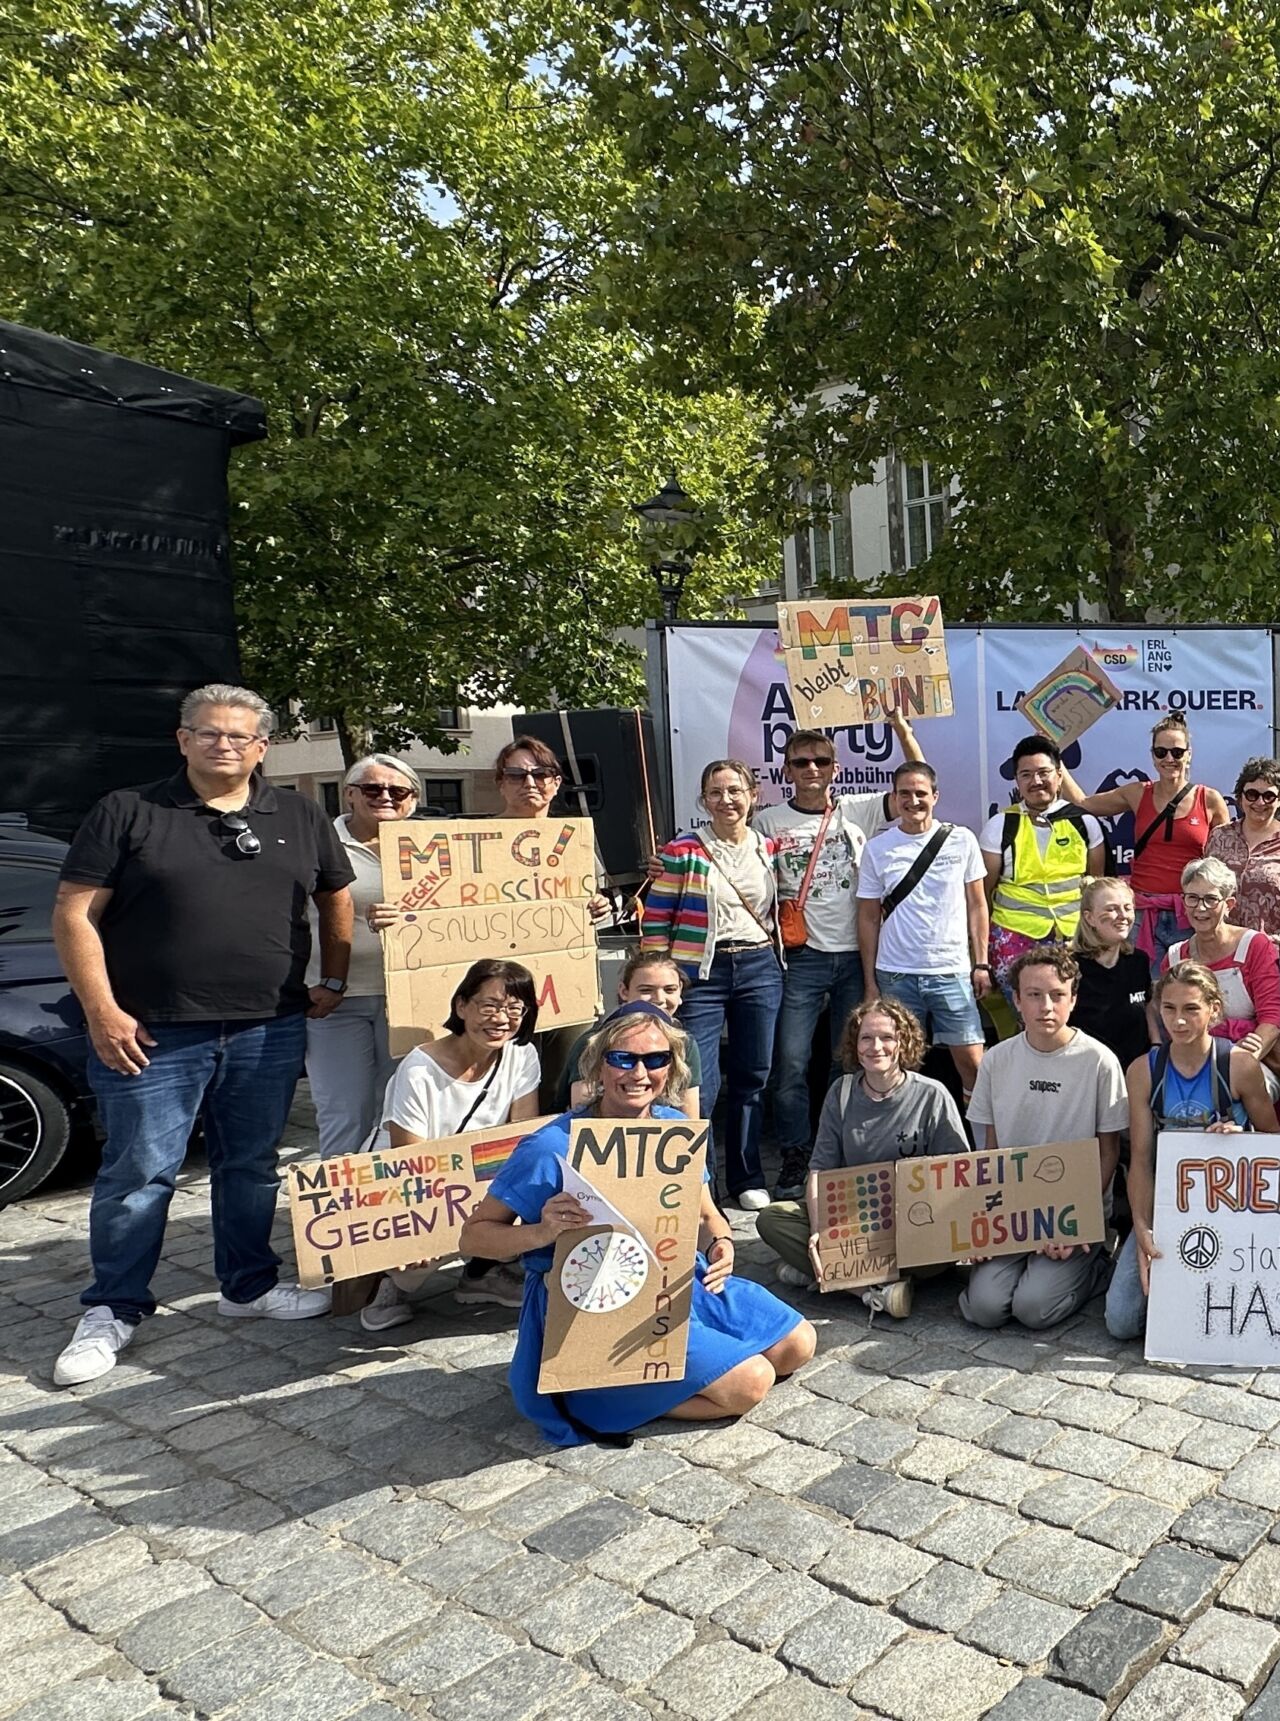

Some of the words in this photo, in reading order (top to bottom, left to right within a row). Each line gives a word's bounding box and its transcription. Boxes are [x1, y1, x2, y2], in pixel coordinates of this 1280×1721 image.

[1104, 655, 1127, 665] CSD
[1147, 640, 1168, 650] ERL
[1147, 651, 1172, 662] ANG
[795, 659, 850, 702] bleibt
[858, 674, 951, 720] BUNT
[763, 722, 893, 762] prty
[907, 1151, 1029, 1193] STREIT
[305, 1206, 438, 1250] GEGEN
[839, 1236, 880, 1259] VIEL
[950, 1204, 1079, 1253] LÖSUNG
[823, 1253, 896, 1282] GEWINNT
